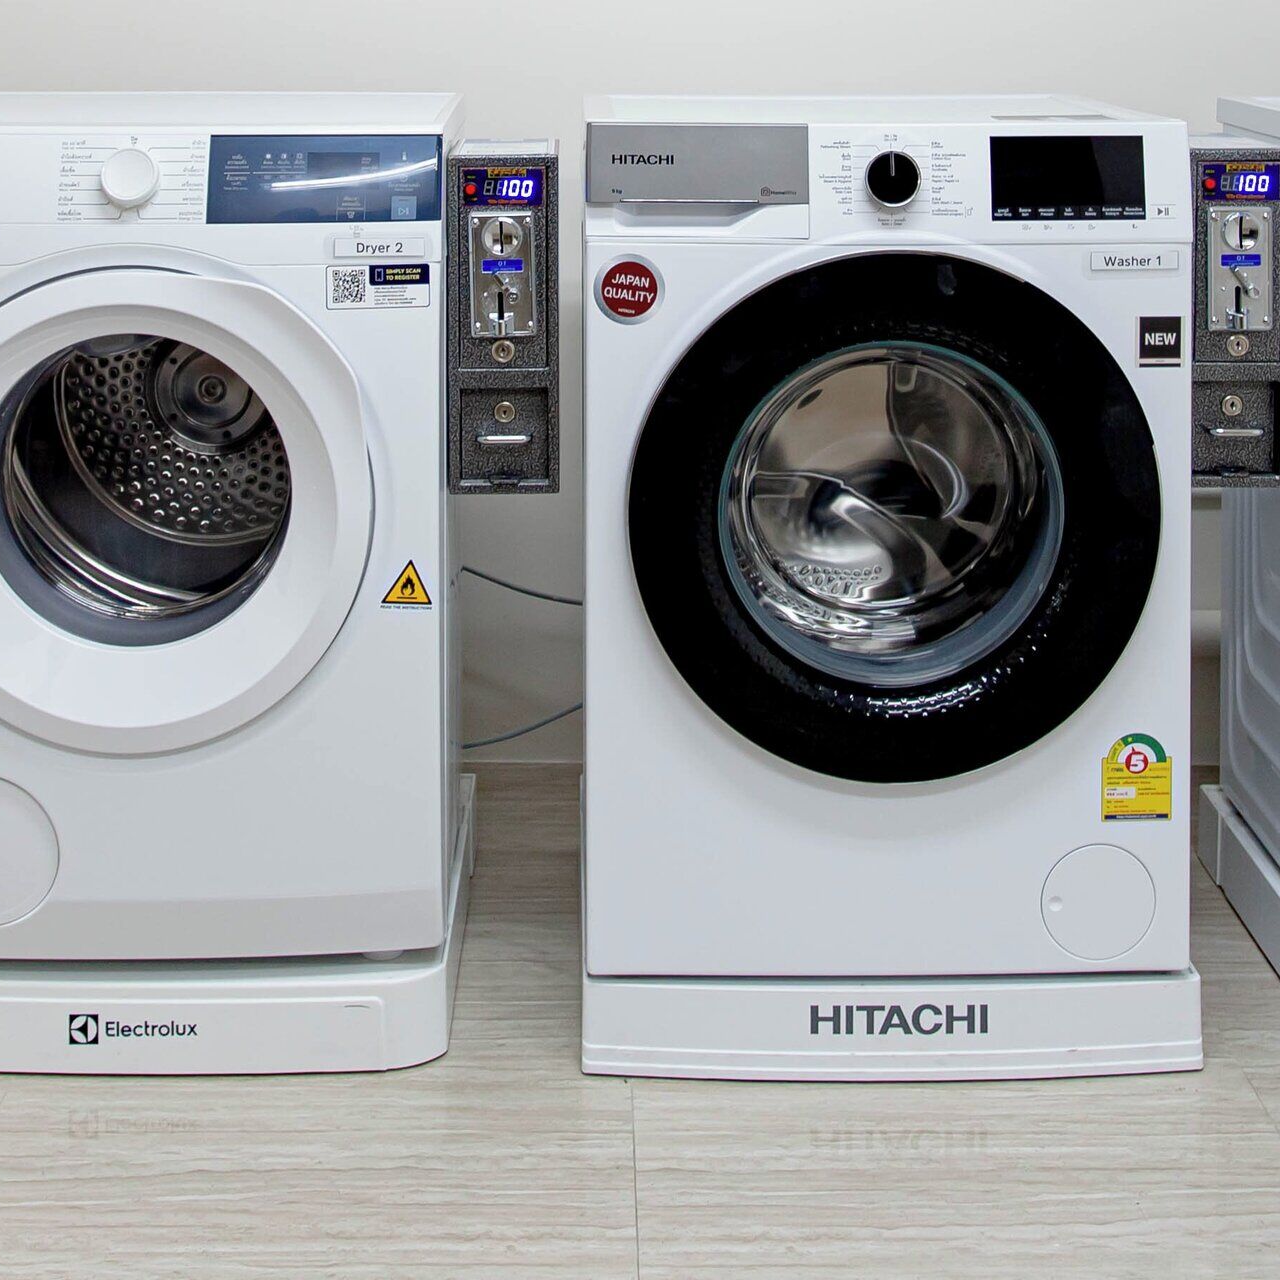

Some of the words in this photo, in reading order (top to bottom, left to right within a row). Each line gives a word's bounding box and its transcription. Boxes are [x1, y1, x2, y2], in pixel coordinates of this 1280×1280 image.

[611, 154, 675, 165] HITACHI
[502, 179, 534, 197] 100
[1238, 174, 1270, 192] 100
[356, 242, 392, 255] Dryer
[395, 242, 403, 254] 2
[1104, 255, 1152, 267] Washer
[1156, 255, 1162, 266] 1
[611, 273, 650, 288] JAPAN
[604, 286, 654, 303] QUALITY
[1144, 332, 1177, 345] NEW
[1129, 753, 1145, 773] 5
[809, 1004, 989, 1036] HITACHI
[105, 1020, 198, 1038] Electrolux
